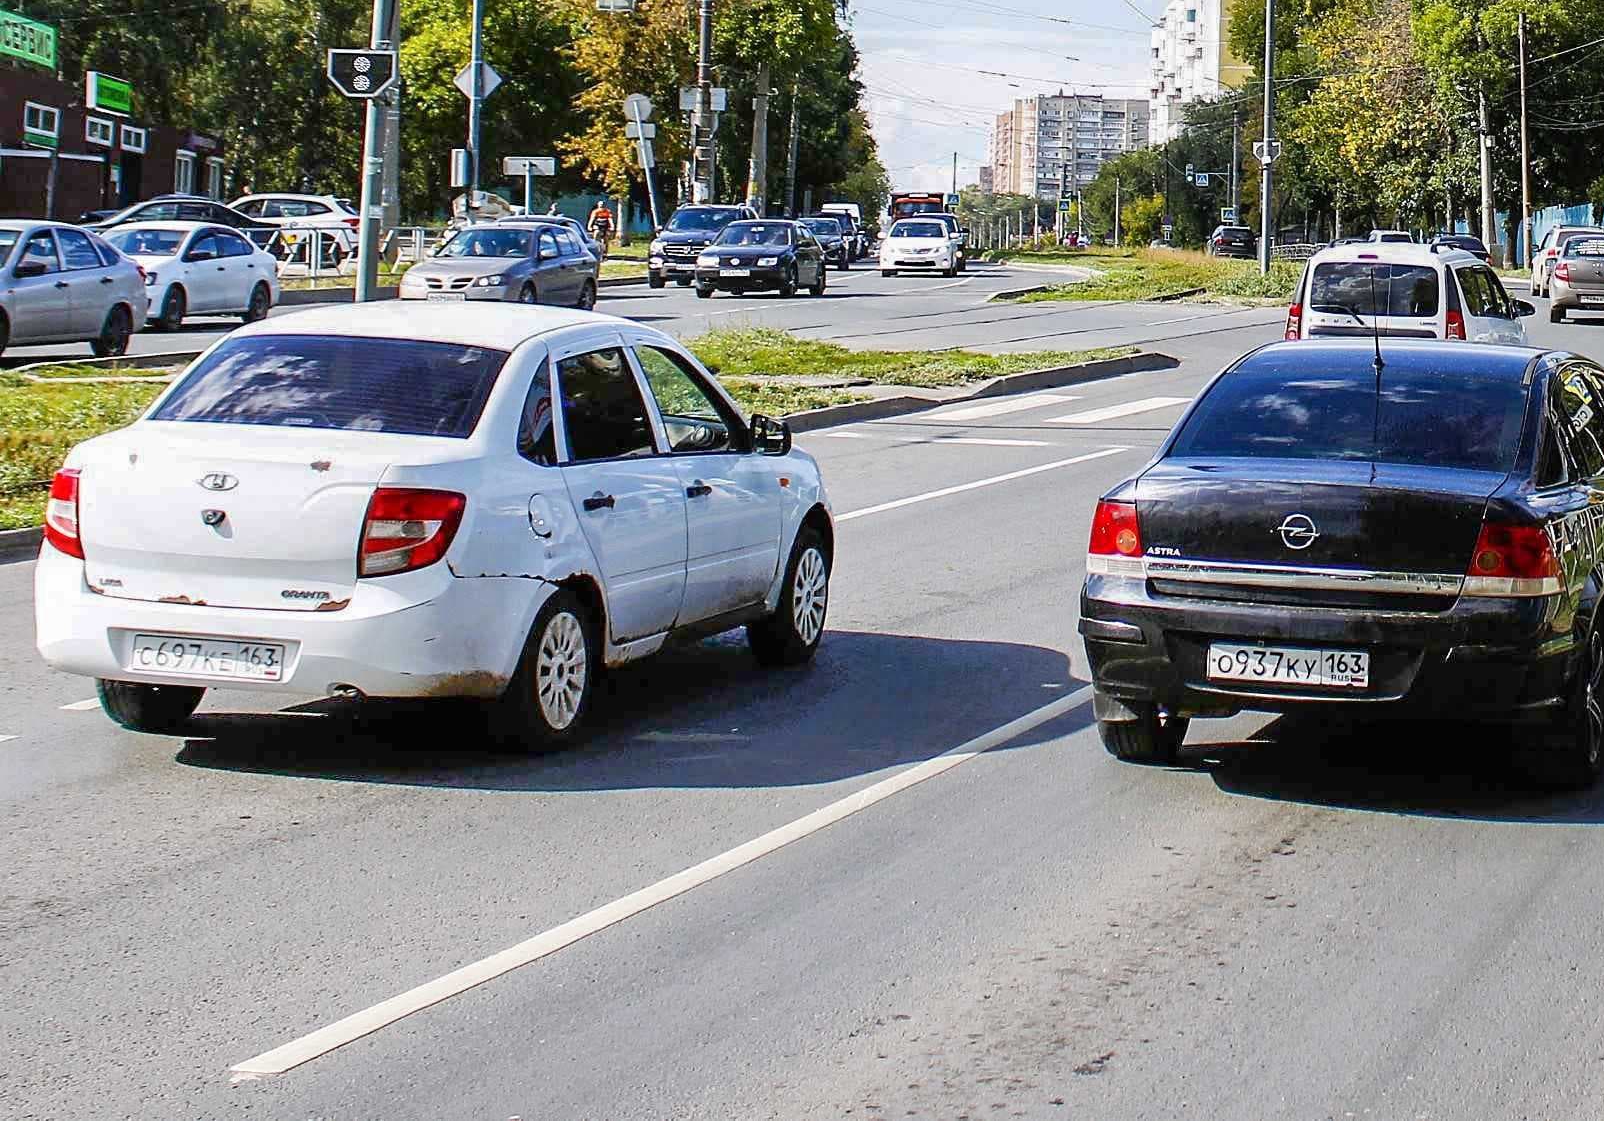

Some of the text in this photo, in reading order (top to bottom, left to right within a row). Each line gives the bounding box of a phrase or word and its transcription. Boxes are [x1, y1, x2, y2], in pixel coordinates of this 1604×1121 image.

[1147, 547, 1181, 556] ASTRA
[139, 641, 276, 672] С697КЕ 163
[1217, 649, 1363, 679] О937КУ 163
